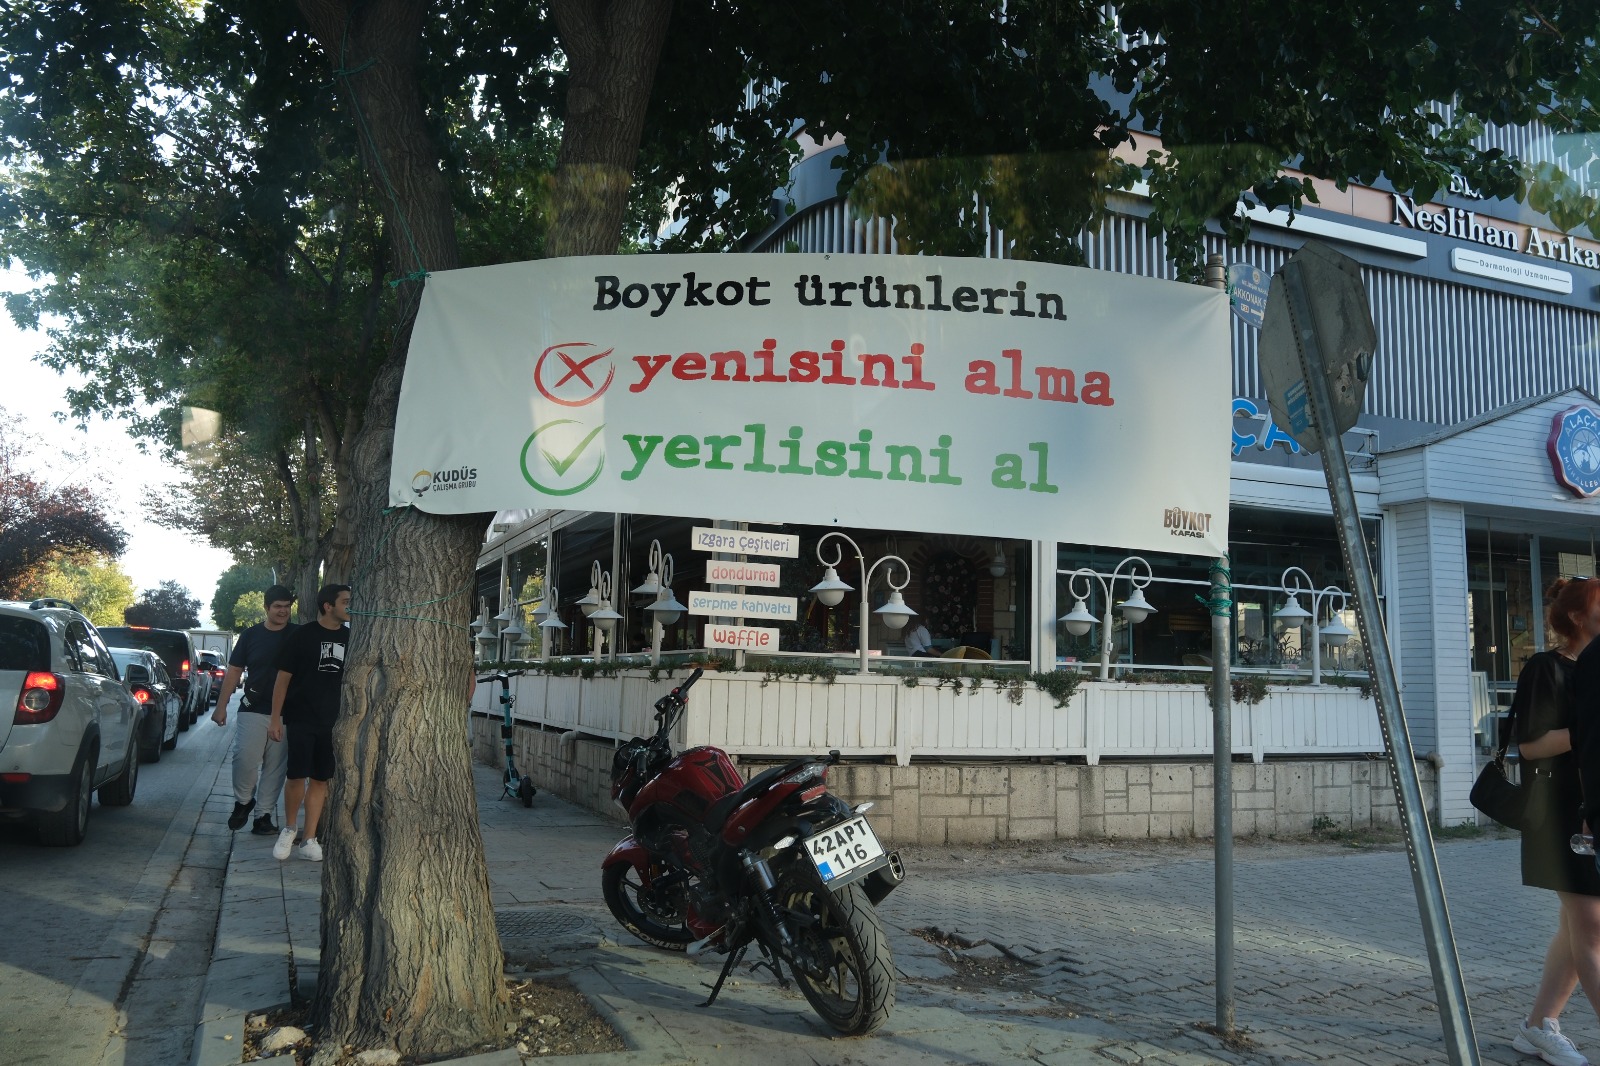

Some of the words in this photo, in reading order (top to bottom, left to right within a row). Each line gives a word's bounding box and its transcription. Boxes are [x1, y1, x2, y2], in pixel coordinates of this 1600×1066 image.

[1393, 194, 1519, 250] Neslihan
[1526, 227, 1600, 269] Arıka
[1525, 269, 1550, 281] Uzmanı
[593, 272, 771, 317] Boykot
[794, 275, 1067, 321] ürünlerin
[629, 339, 936, 393] yenisini
[964, 349, 1115, 406] alma
[620, 424, 963, 485] yerlisini
[991, 442, 1059, 494] al
[433, 466, 477, 483] KUDÜS
[458, 481, 477, 489] GRUBU
[712, 566, 776, 582] dondurma
[692, 597, 738, 611] serpme
[741, 599, 792, 614] kahvaltı
[713, 628, 770, 647] waffle
[813, 820, 866, 855] 42APT
[834, 843, 868, 869] 116
